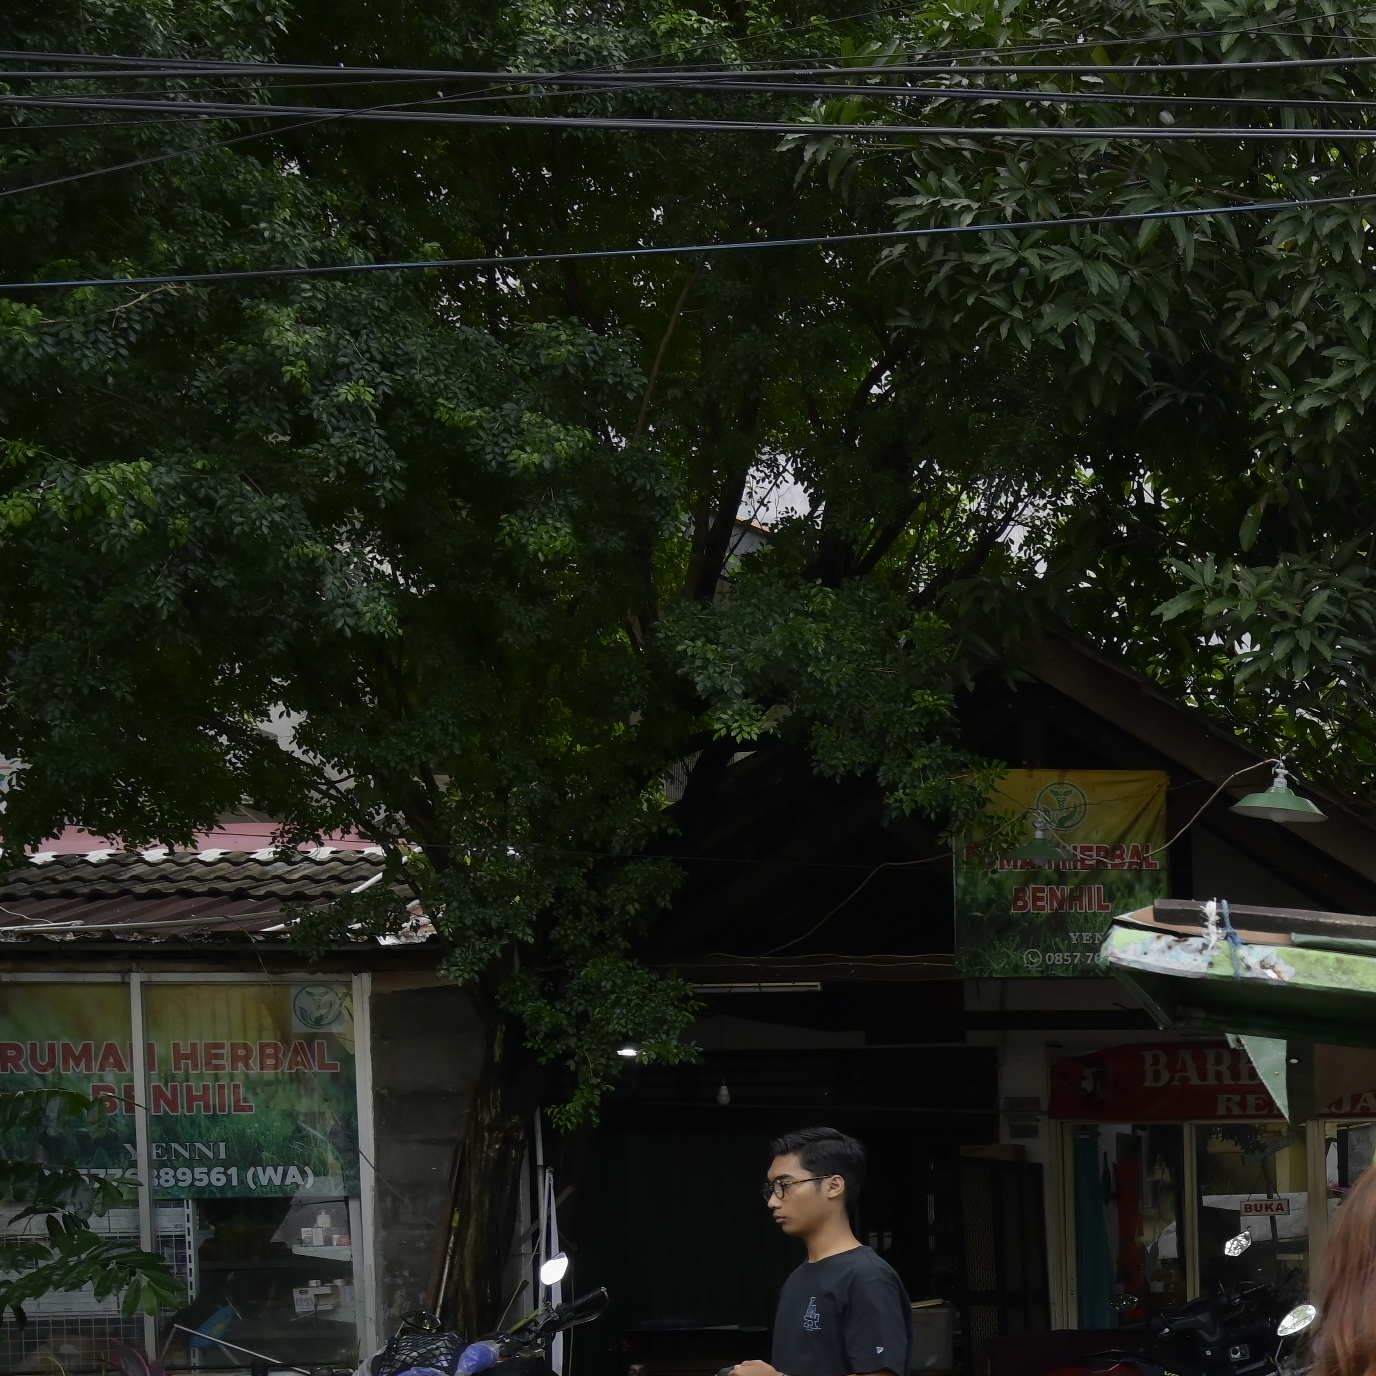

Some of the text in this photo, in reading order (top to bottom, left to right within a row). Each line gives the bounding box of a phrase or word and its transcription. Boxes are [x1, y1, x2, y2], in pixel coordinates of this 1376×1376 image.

[1011, 884, 1112, 912] BENHIL
[1045, 953, 1078, 965] 0857
[171, 1040, 340, 1073] HERBAL
[247, 1166, 314, 1190] (WA)
[1243, 1202, 1285, 1214] BUKA
